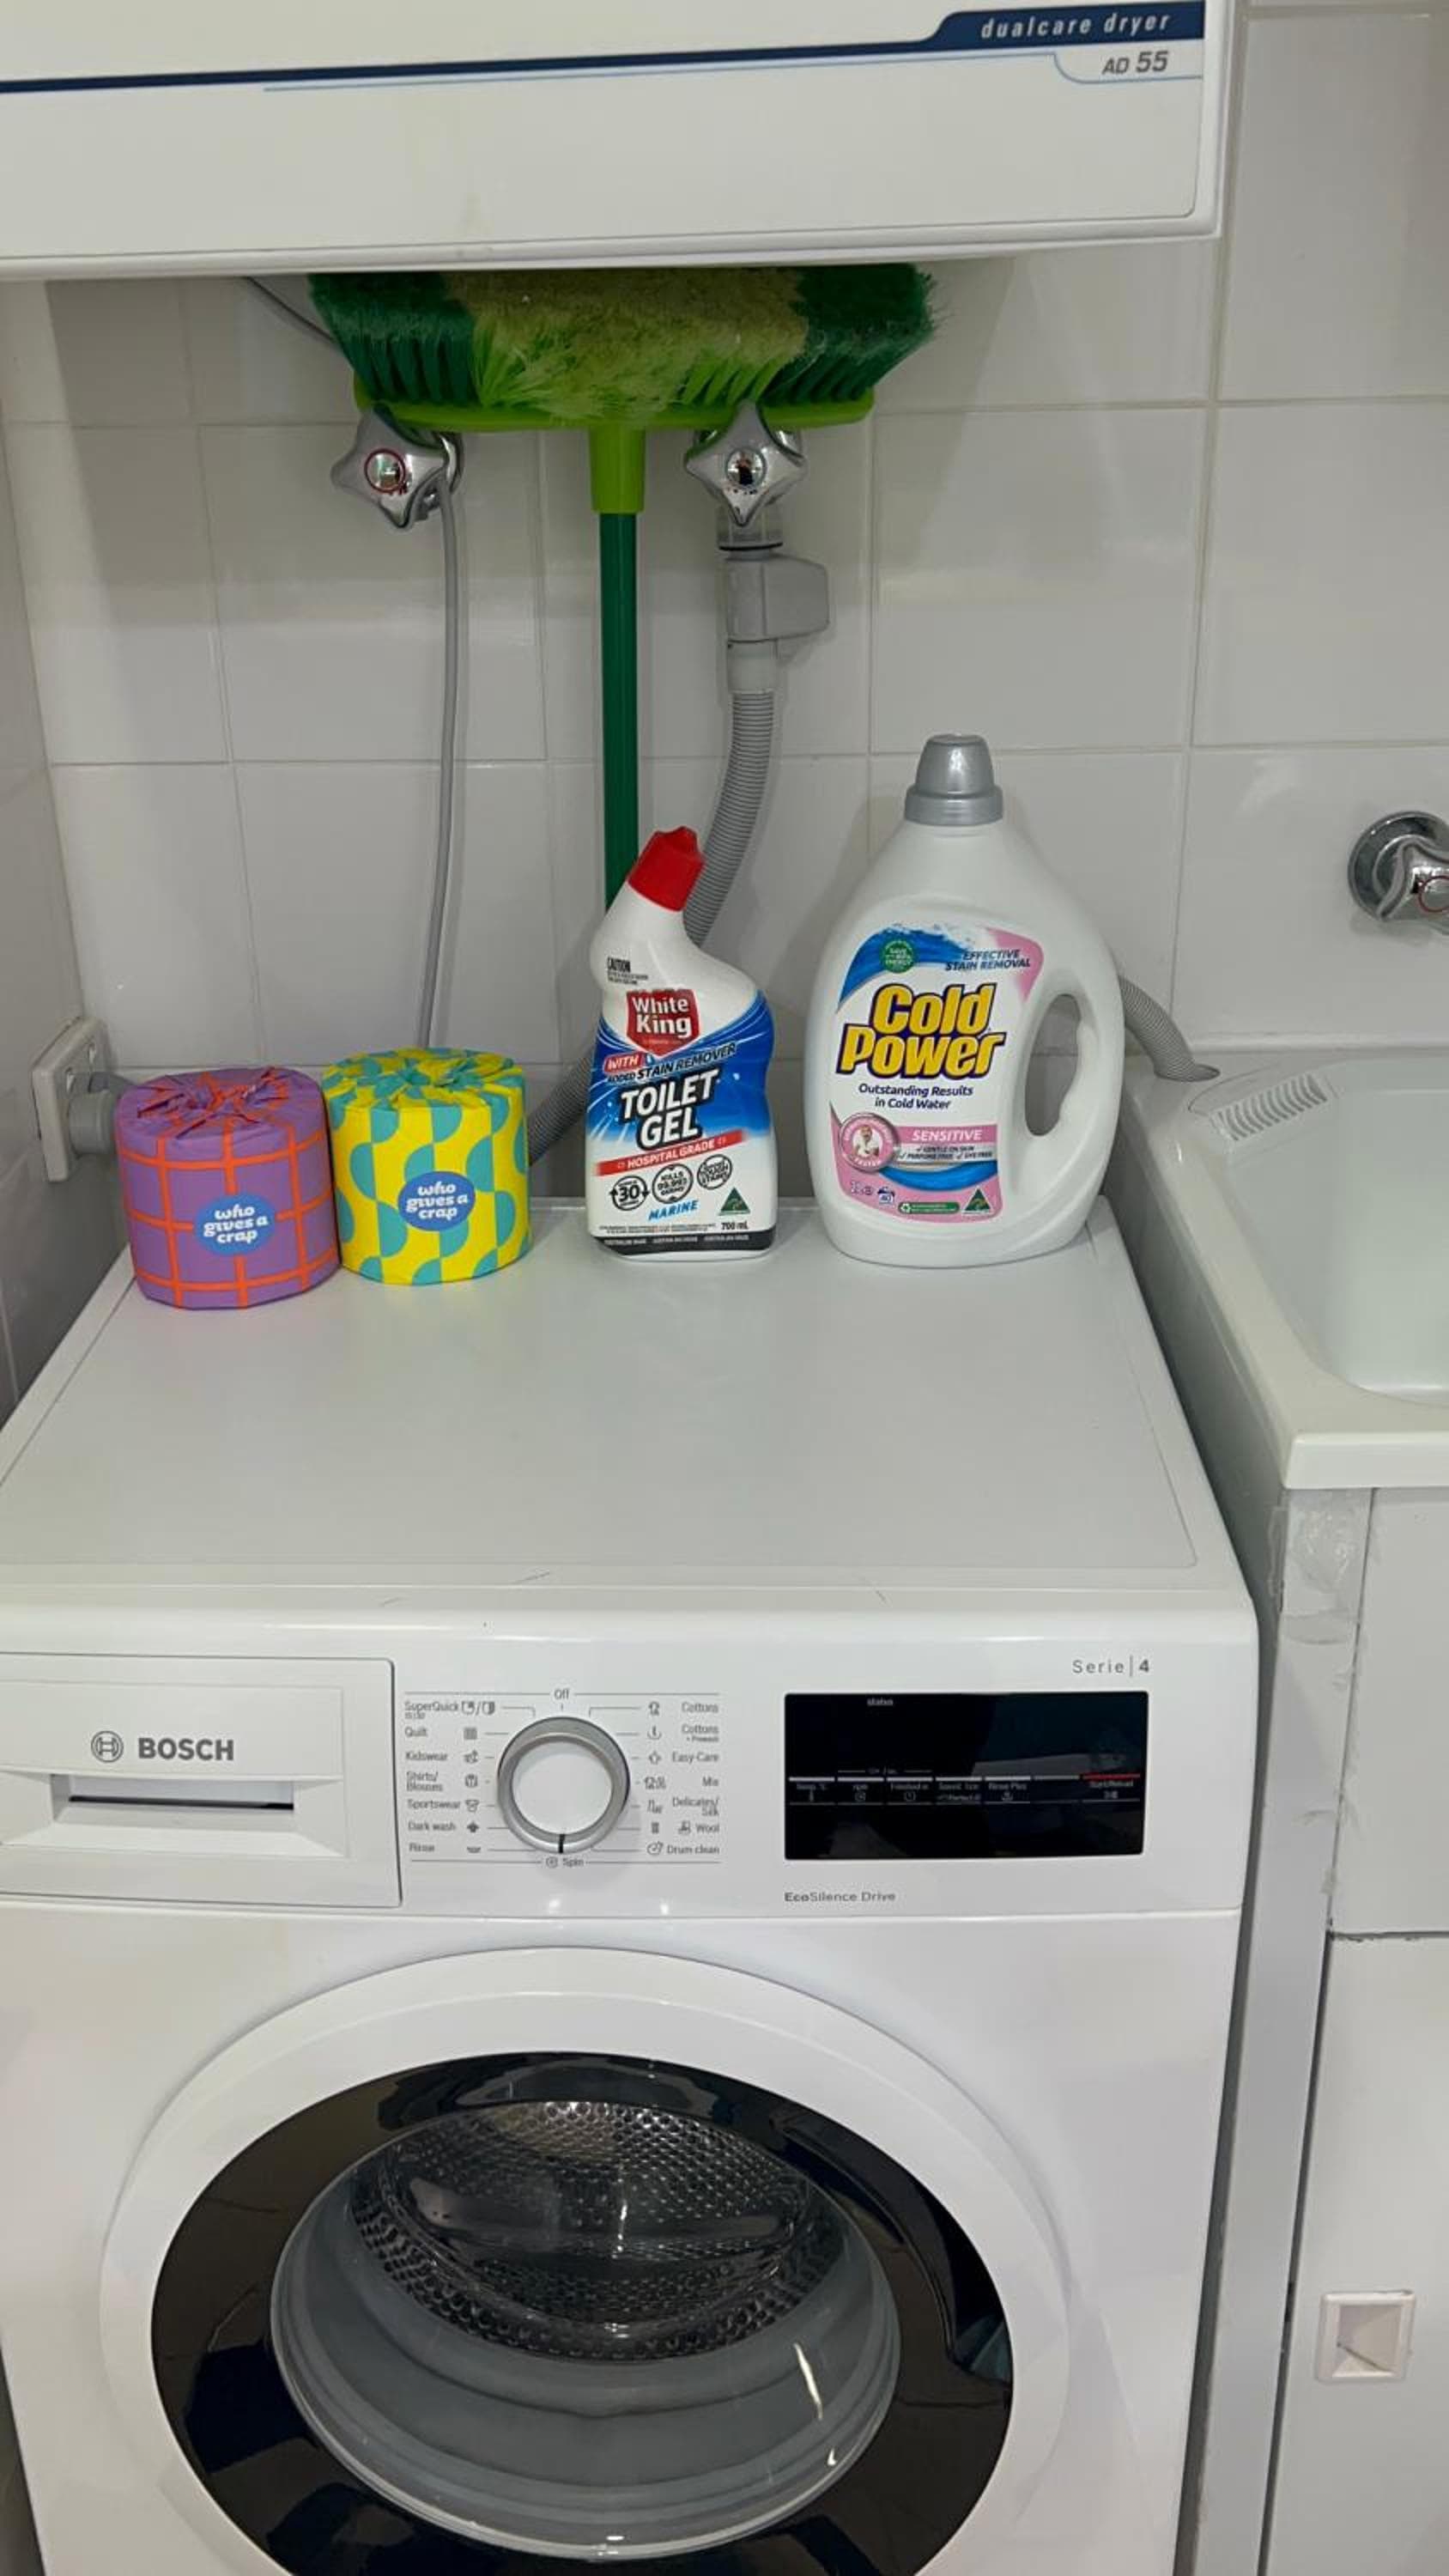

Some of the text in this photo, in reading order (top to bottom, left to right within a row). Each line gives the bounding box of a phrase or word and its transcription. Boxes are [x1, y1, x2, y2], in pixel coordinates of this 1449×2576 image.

[981, 13, 1170, 39] dualcare dryer
[1101, 51, 1168, 75] AD 55
[963, 949, 1020, 960] EFFECTIVE
[945, 957, 1030, 971] STAIN REMOVAL
[632, 997, 689, 1014] White
[869, 981, 997, 1036] Cold
[636, 1014, 692, 1039] King
[835, 1024, 1007, 1079] Power
[608, 1054, 639, 1069] WITH
[638, 1063, 673, 1079] STAIN
[676, 1042, 737, 1069] REMOVER
[621, 1067, 719, 1120] TOILET
[858, 1084, 973, 1097] Outstanding Results
[875, 1097, 951, 1109] in Cold Water
[640, 1106, 699, 1149] GEL
[912, 1129, 983, 1141] SENSITIVE
[627, 1139, 715, 1169] HOSPITAL GRADE
[417, 1181, 457, 1196] who
[618, 1184, 641, 1202] 30
[406, 1194, 469, 1213] gives a
[648, 1200, 699, 1221] MARINE
[215, 1204, 256, 1220] who
[418, 1206, 458, 1221] crap
[203, 1216, 270, 1237] gives a
[217, 1230, 258, 1244] crap
[1072, 1659, 1149, 1674] Serie 4
[554, 1689, 570, 1700] Off
[682, 1702, 718, 1713] Cottons
[682, 1724, 719, 1734] Cottons
[138, 1738, 234, 1760] BOSCH
[785, 1891, 895, 1902] EcoSilence Drive
